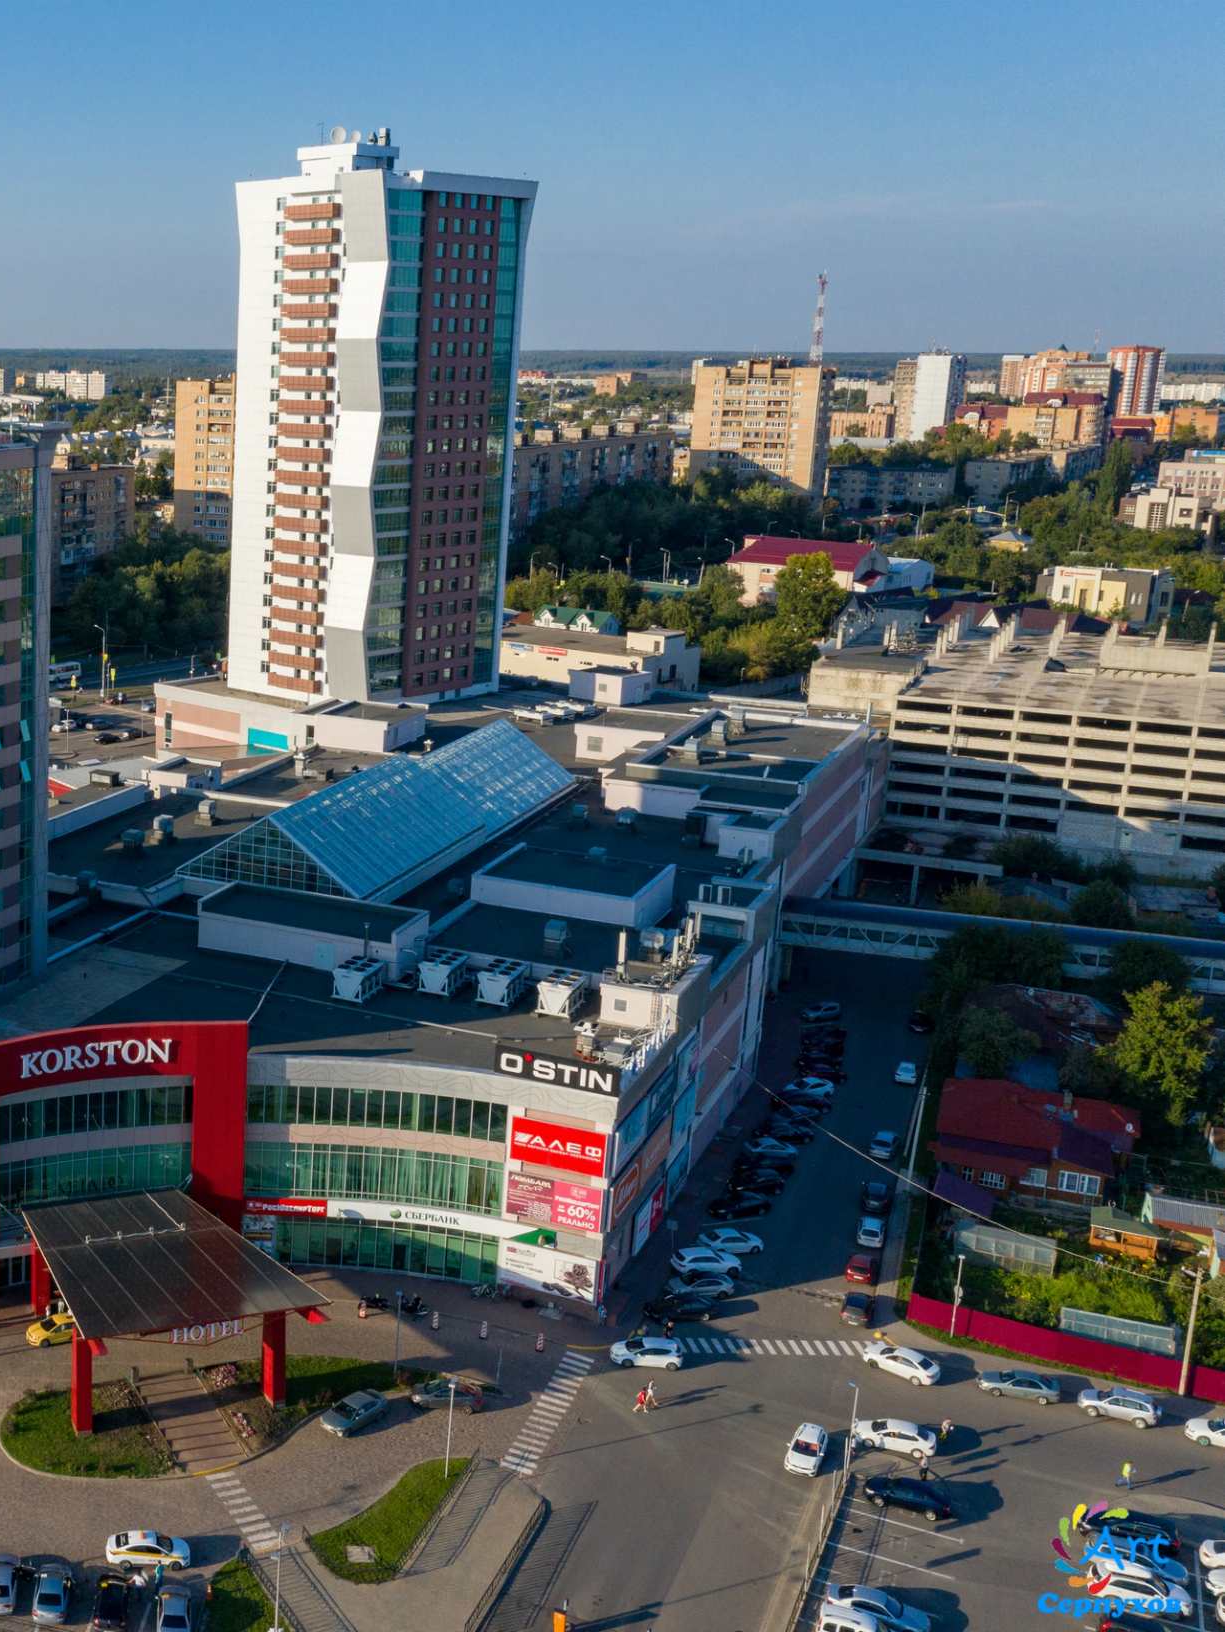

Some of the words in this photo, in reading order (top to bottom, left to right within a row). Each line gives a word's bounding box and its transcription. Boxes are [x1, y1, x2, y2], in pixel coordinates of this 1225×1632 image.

[20, 1038, 173, 1079] KORSTON
[405, 1210, 461, 1225] СБЕРБАНК
[567, 1205, 597, 1222] 60%
[170, 1318, 245, 1344] HOTEL
